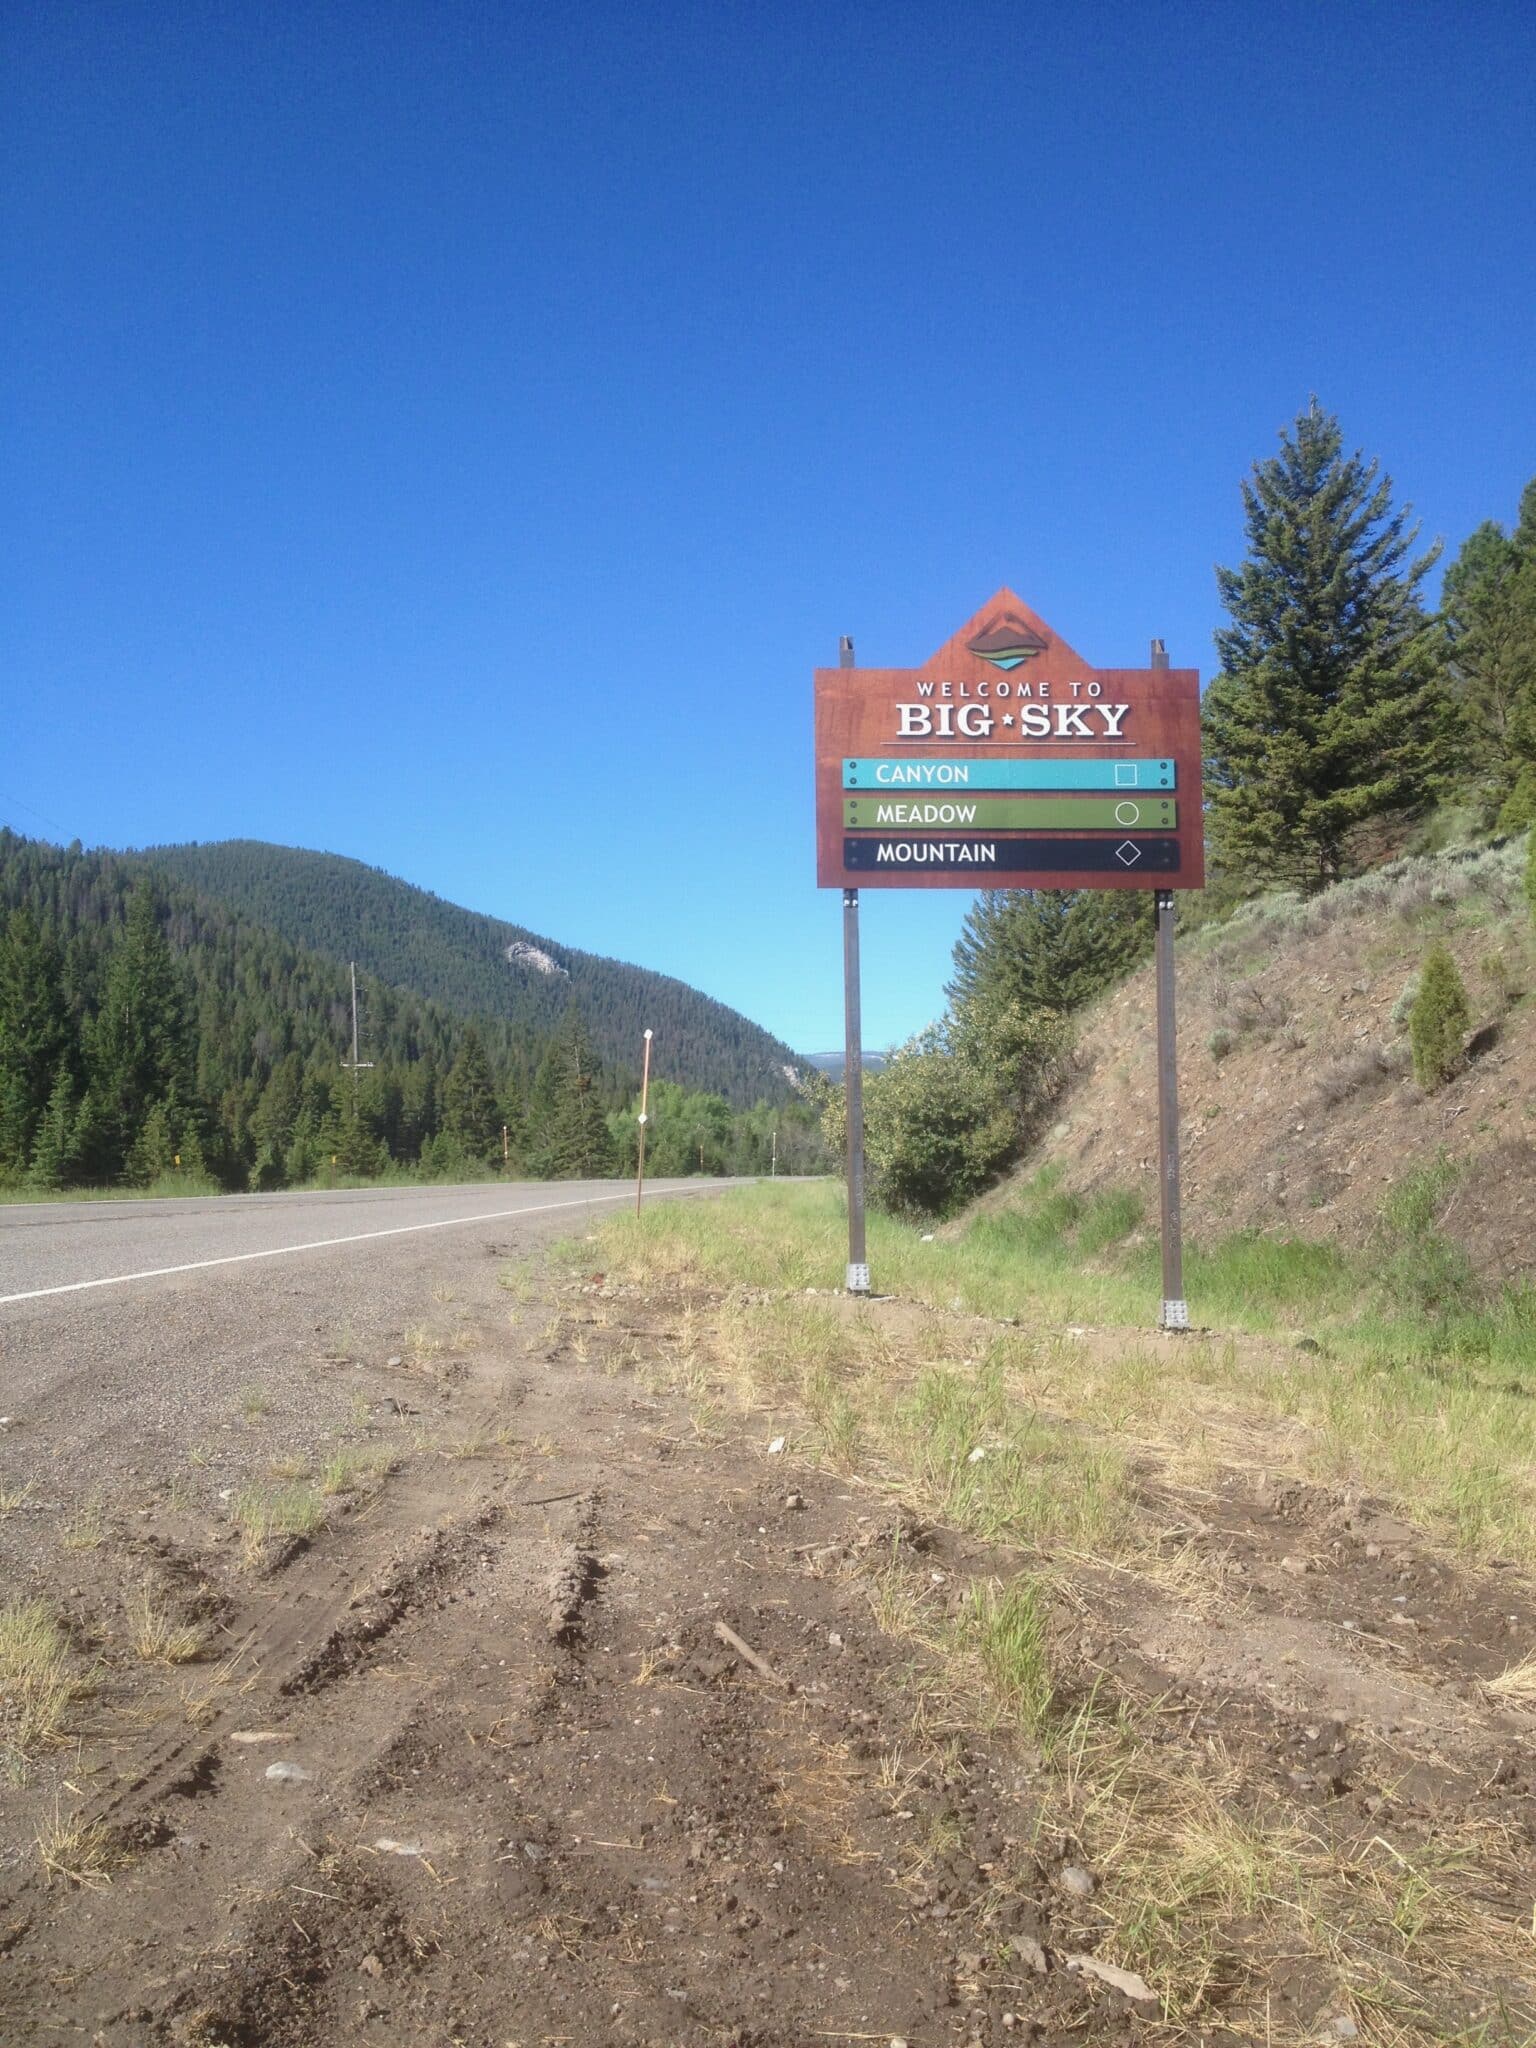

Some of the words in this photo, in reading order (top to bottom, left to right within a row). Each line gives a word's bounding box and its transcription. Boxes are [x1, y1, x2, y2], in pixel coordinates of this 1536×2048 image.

[917, 682, 1050, 697] WELCOME
[1069, 682, 1102, 697] TO
[896, 703, 994, 737] BIG
[1020, 703, 1129, 737] SKY
[875, 764, 969, 783] CANYON
[876, 805, 977, 823] MEADOW
[876, 844, 996, 862] MOUNTAIN
